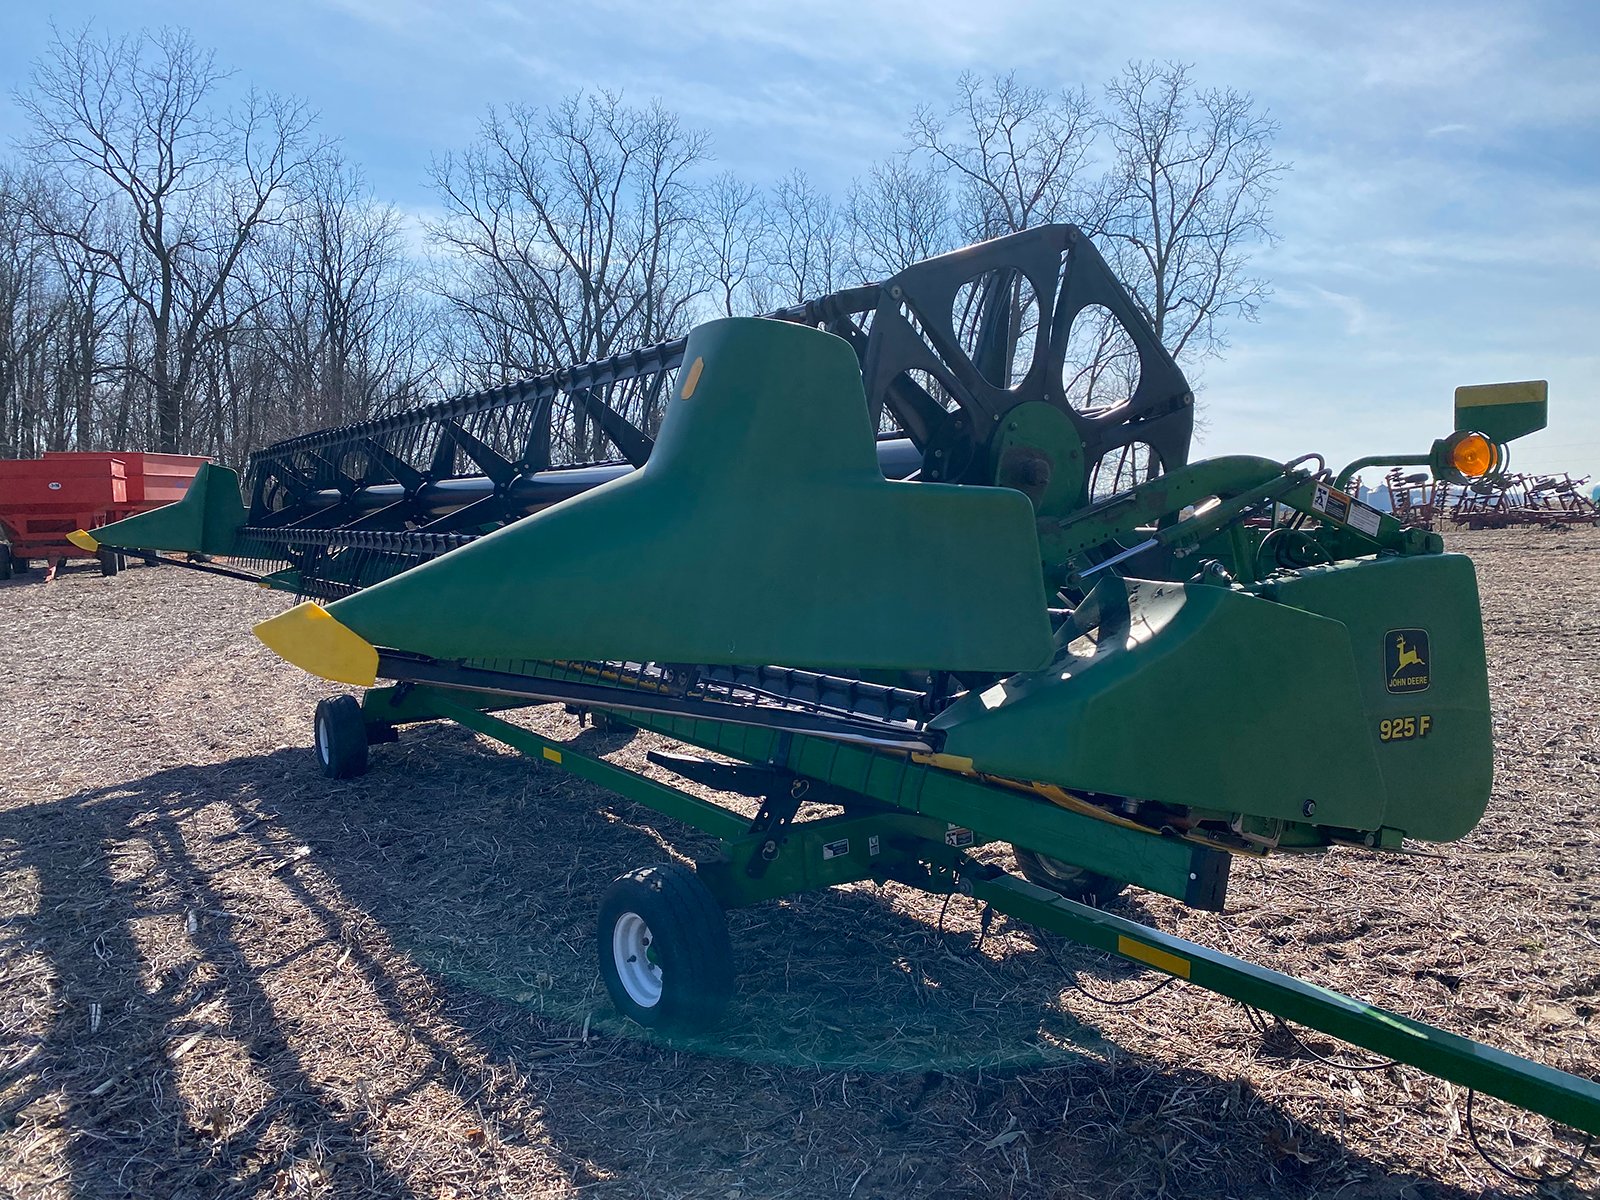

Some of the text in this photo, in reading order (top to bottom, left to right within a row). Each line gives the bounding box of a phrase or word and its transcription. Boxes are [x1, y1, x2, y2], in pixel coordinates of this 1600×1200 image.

[1389, 676, 1428, 687] JOHN DEERE
[1380, 715, 1431, 740] 925 F
